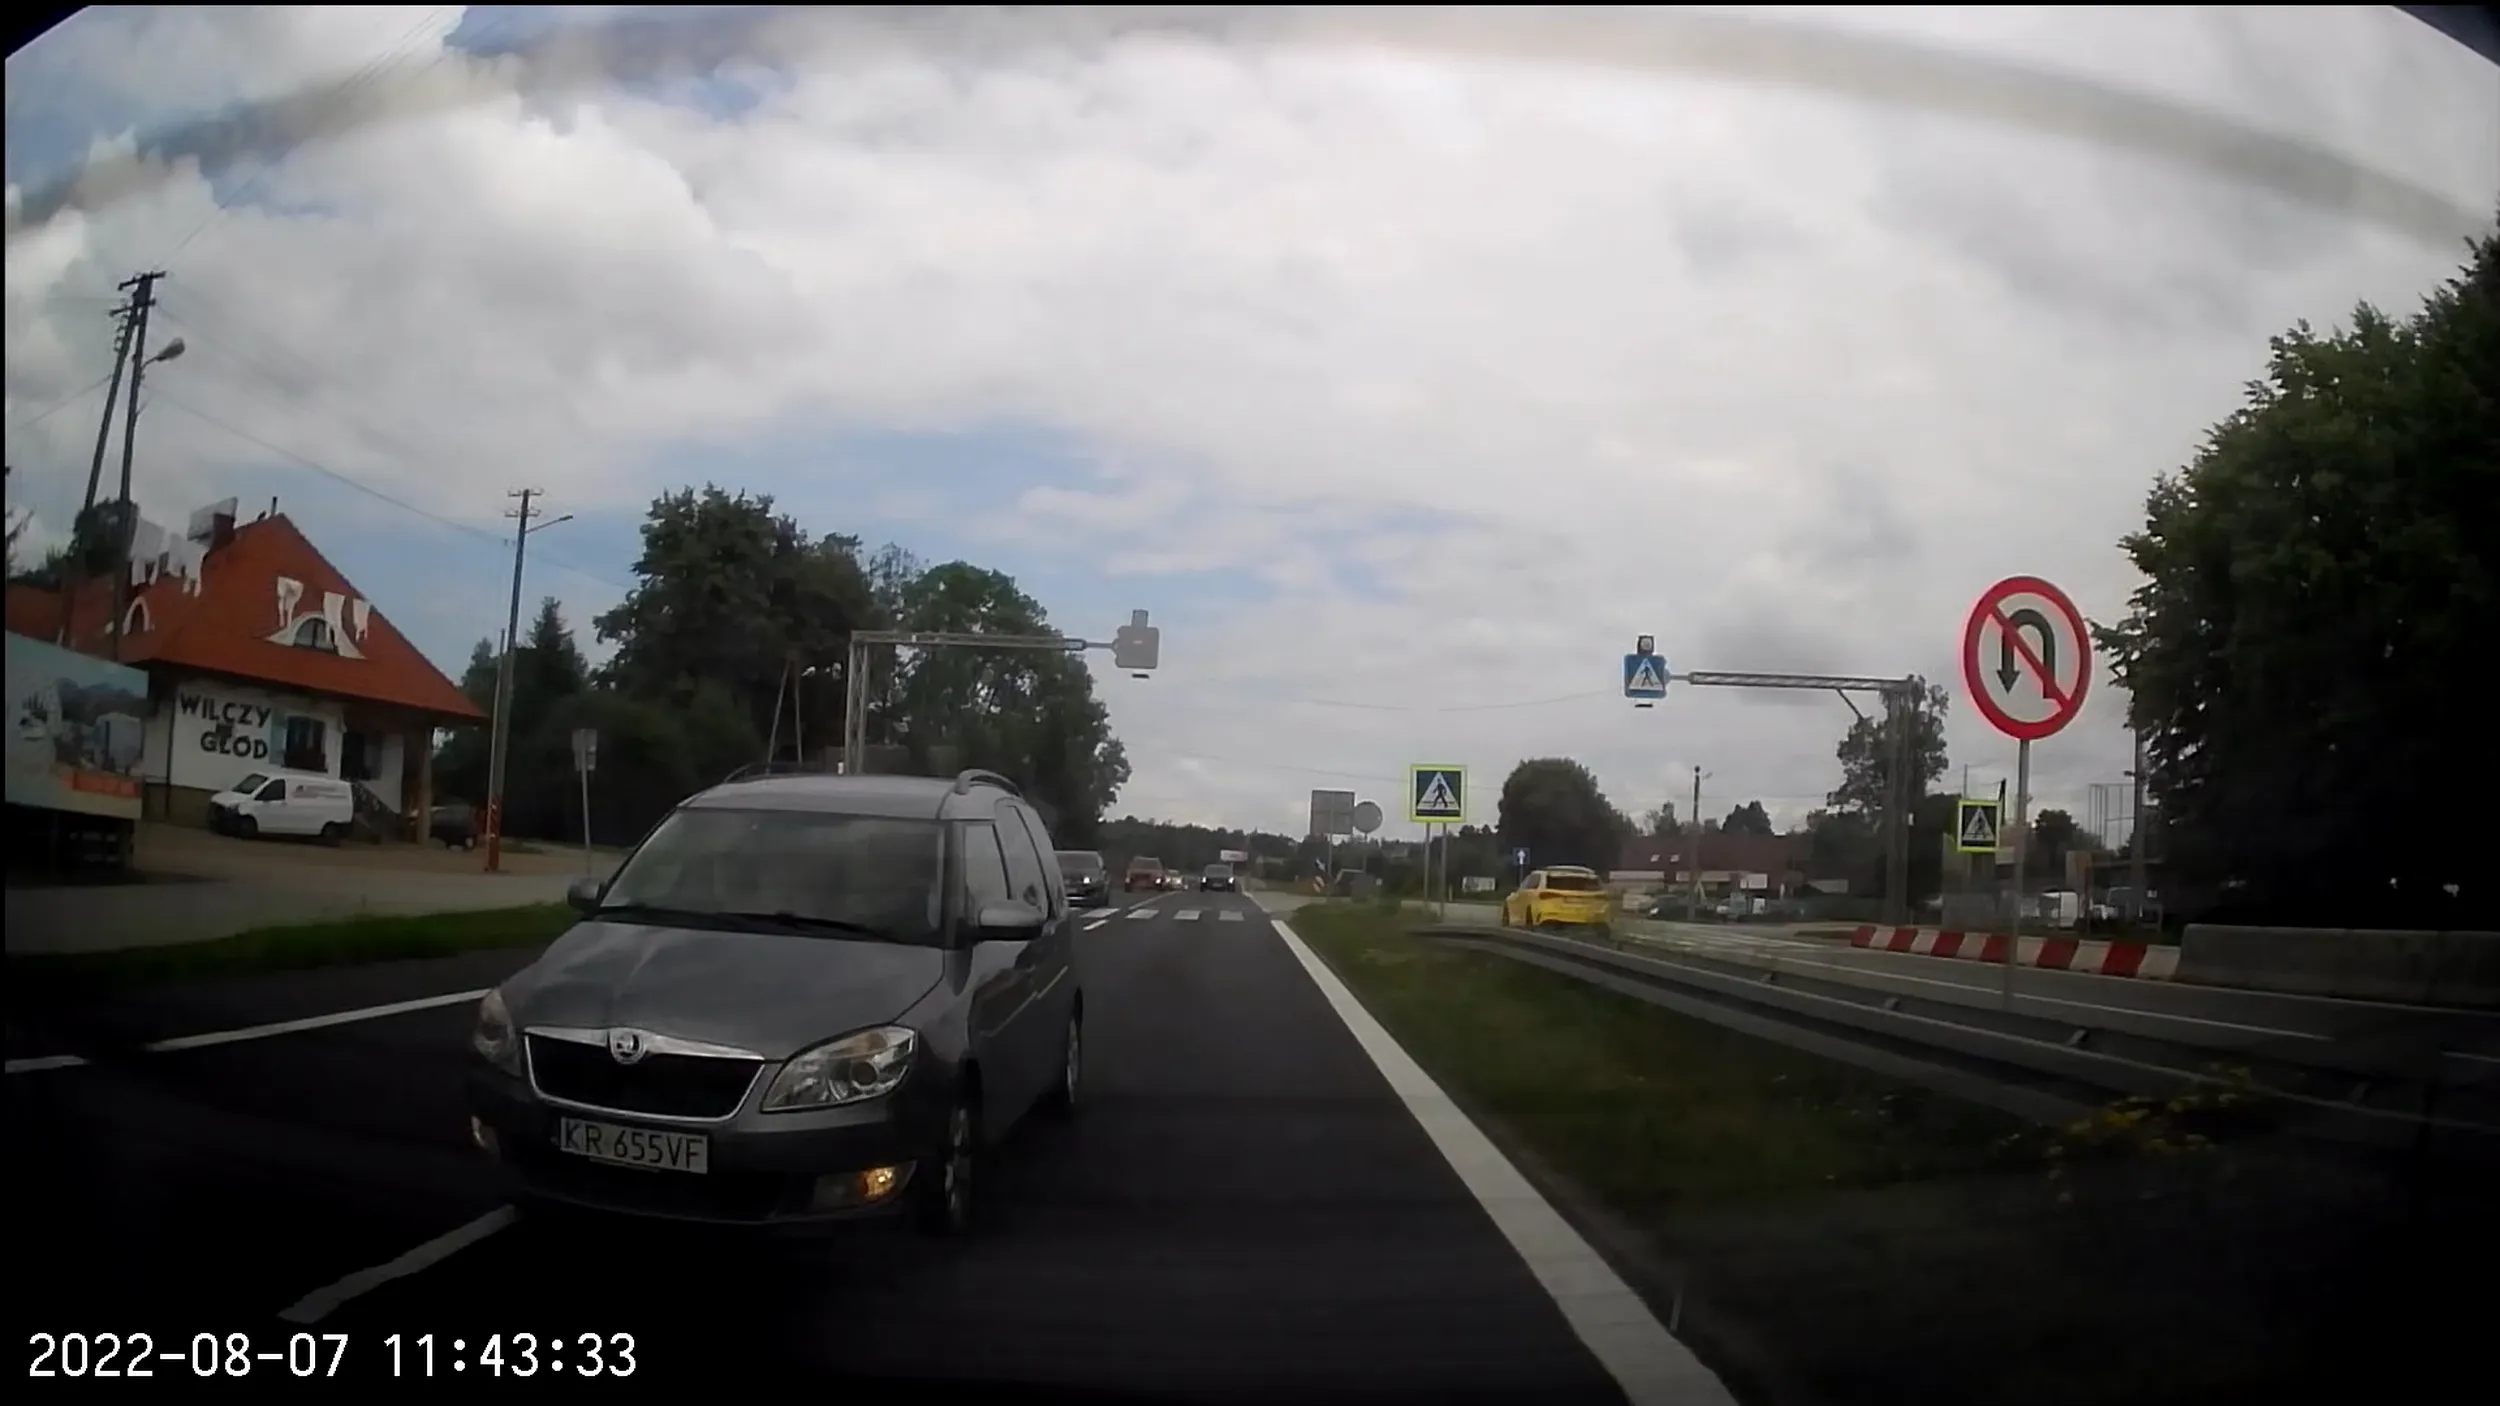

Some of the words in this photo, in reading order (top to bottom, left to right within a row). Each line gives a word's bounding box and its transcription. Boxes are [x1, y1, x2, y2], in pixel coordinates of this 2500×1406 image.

[180, 692, 271, 728] WILCZY
[564, 1119, 602, 1155] KR
[613, 1129, 703, 1170] 655VF
